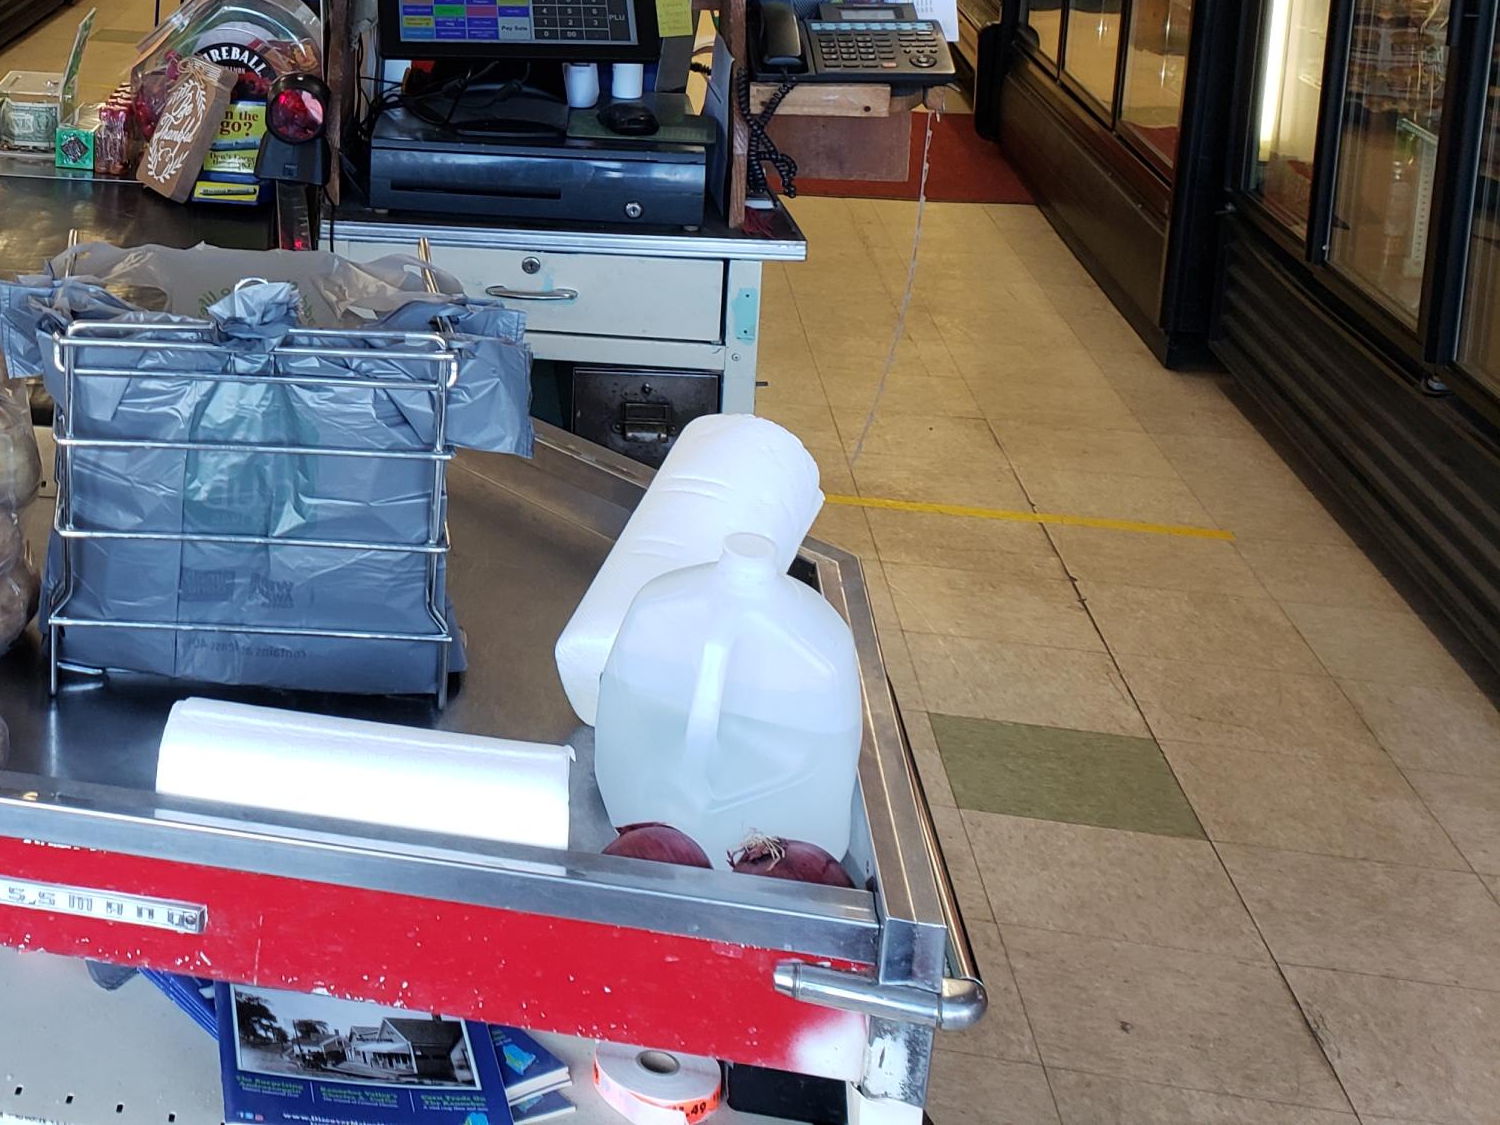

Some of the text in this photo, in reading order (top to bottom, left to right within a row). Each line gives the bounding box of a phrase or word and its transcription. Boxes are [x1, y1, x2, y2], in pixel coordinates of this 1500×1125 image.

[201, 45, 268, 75] IREBALL
[239, 110, 259, 122] the
[220, 121, 254, 137] go?
